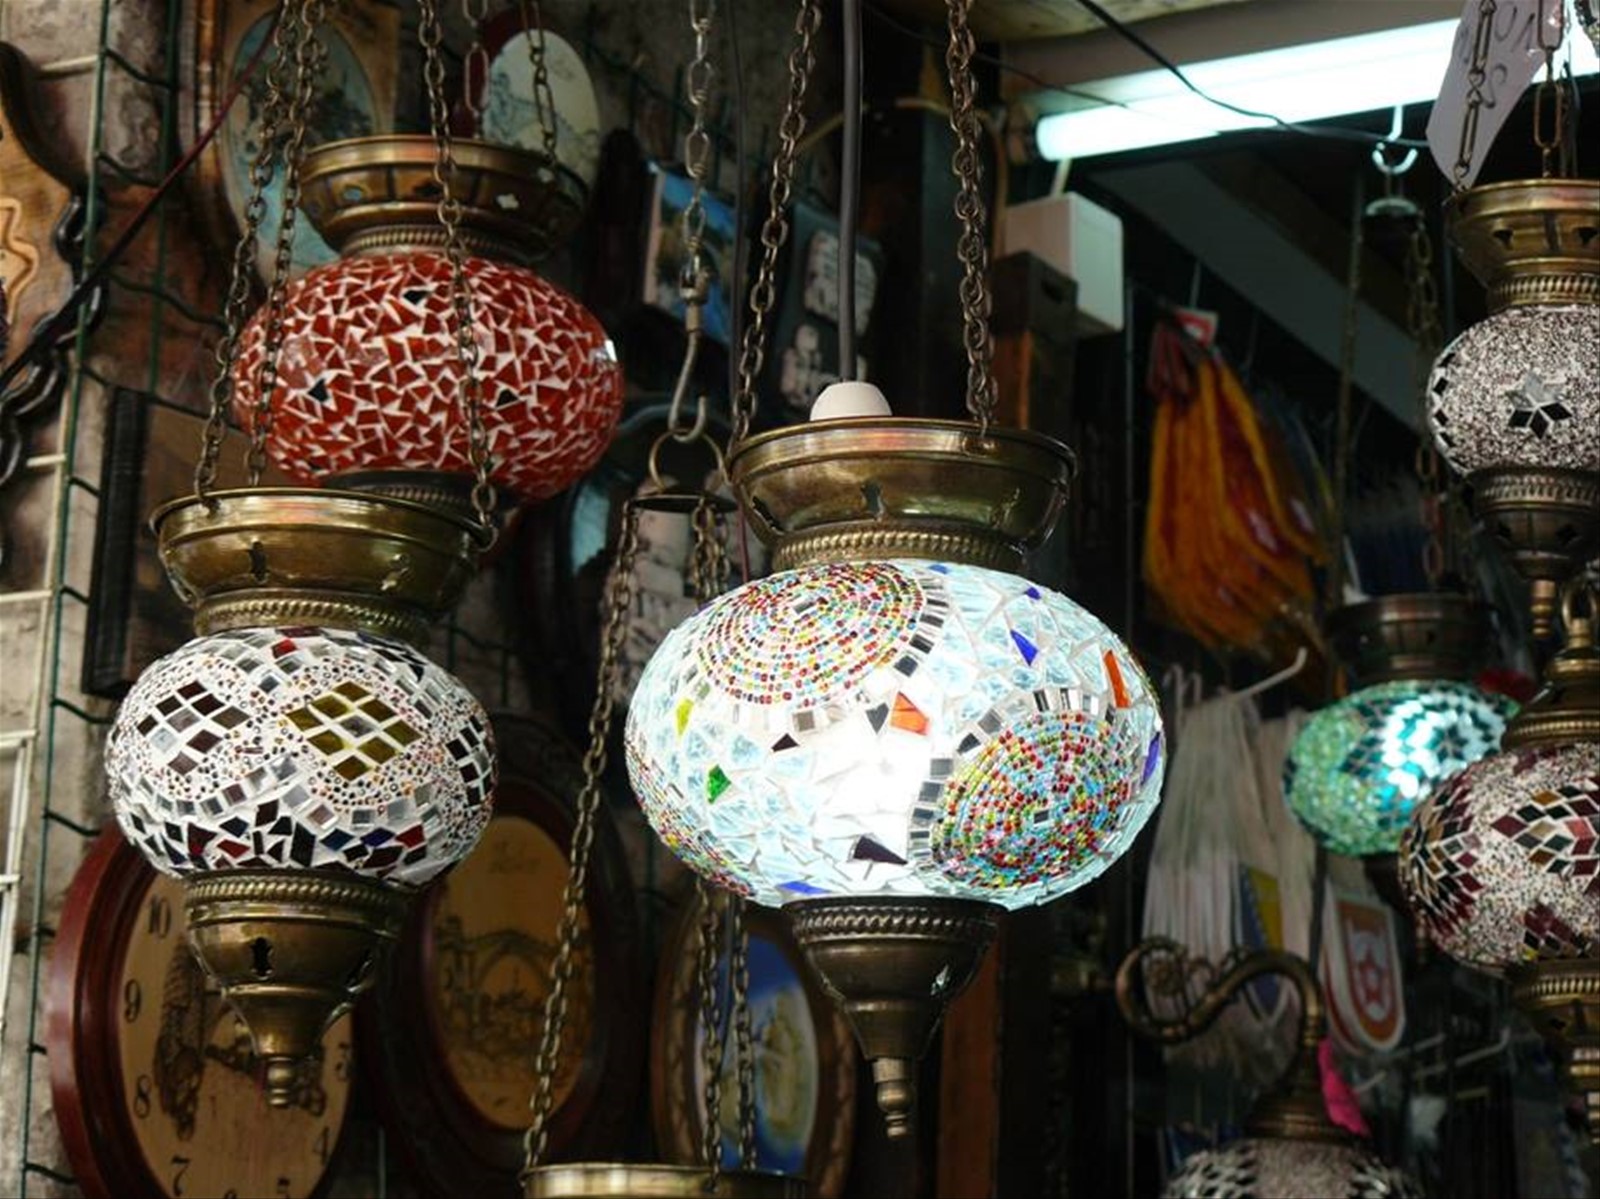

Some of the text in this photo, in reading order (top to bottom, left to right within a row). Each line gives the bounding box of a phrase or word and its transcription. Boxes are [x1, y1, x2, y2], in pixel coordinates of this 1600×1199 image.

[148, 895, 171, 939] 10
[124, 978, 141, 1023] 9
[133, 1074, 151, 1119] 8
[171, 1155, 191, 1197] 7
